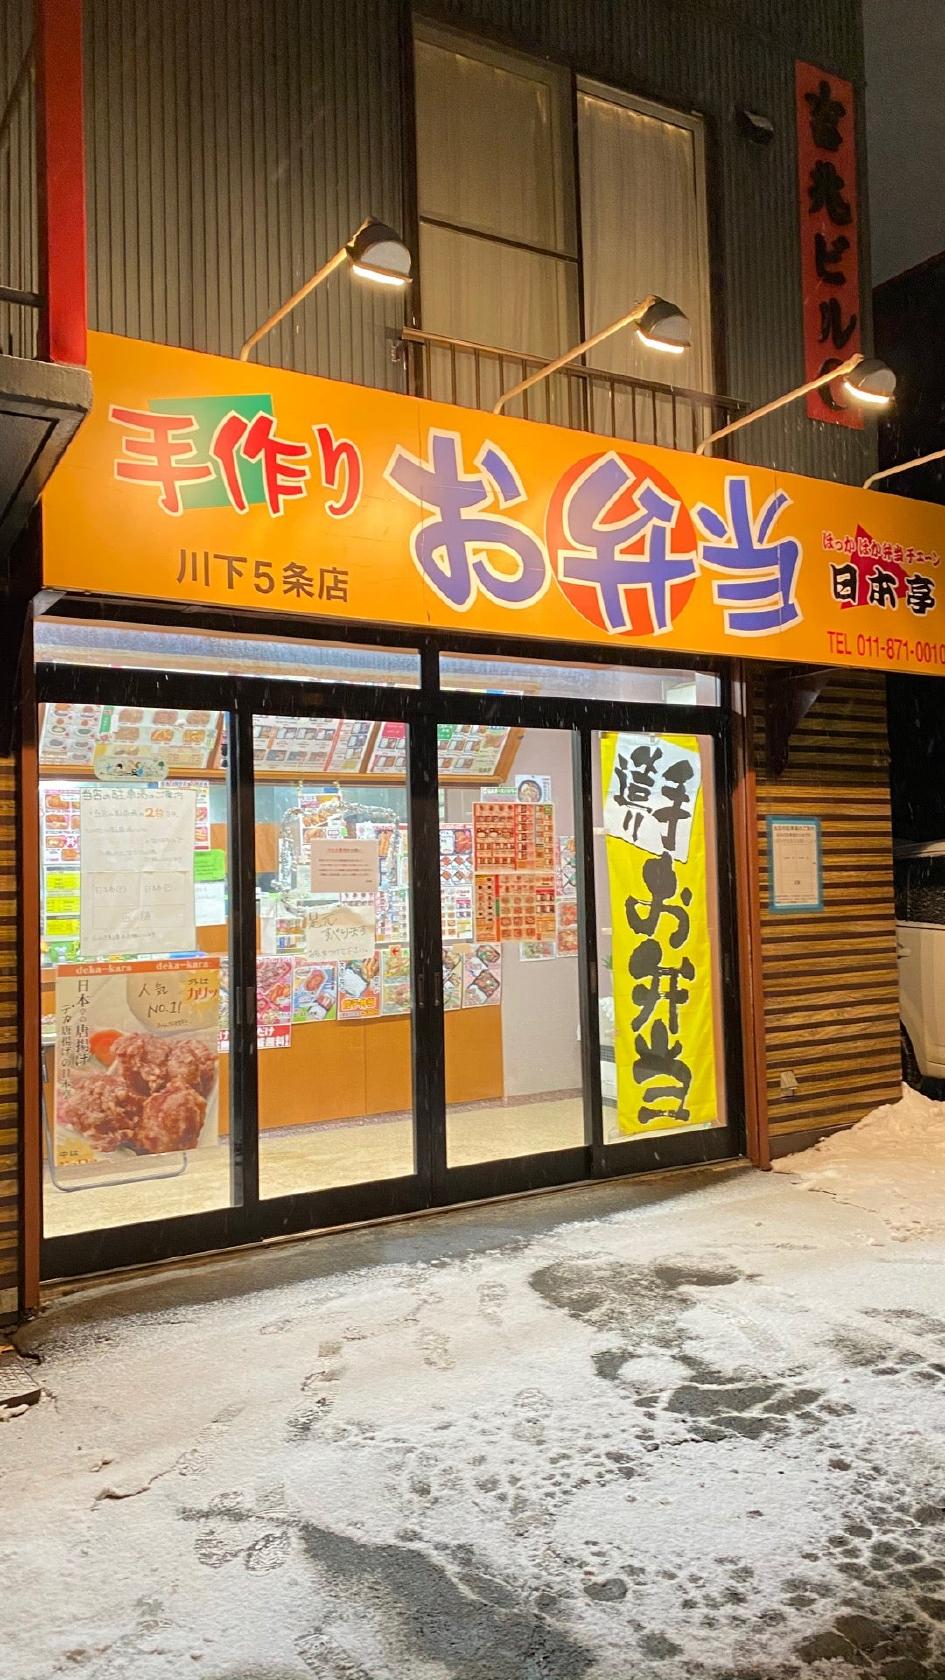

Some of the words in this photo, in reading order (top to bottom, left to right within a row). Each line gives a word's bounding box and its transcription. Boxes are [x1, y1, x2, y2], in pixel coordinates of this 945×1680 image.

[108, 404, 363, 518] 手作り
[383, 427, 803, 637] お弁当
[177, 548, 350, 603] 川下5条店
[830, 562, 936, 616] 日本亭
[827, 630, 852, 655] TEL
[856, 634, 945, 664] 011-871-0010
[75, 964, 133, 976] deka-kara
[138, 981, 168, 998] 人気
[156, 960, 209, 971] deka-kara
[624, 850, 696, 1124] お弁当
